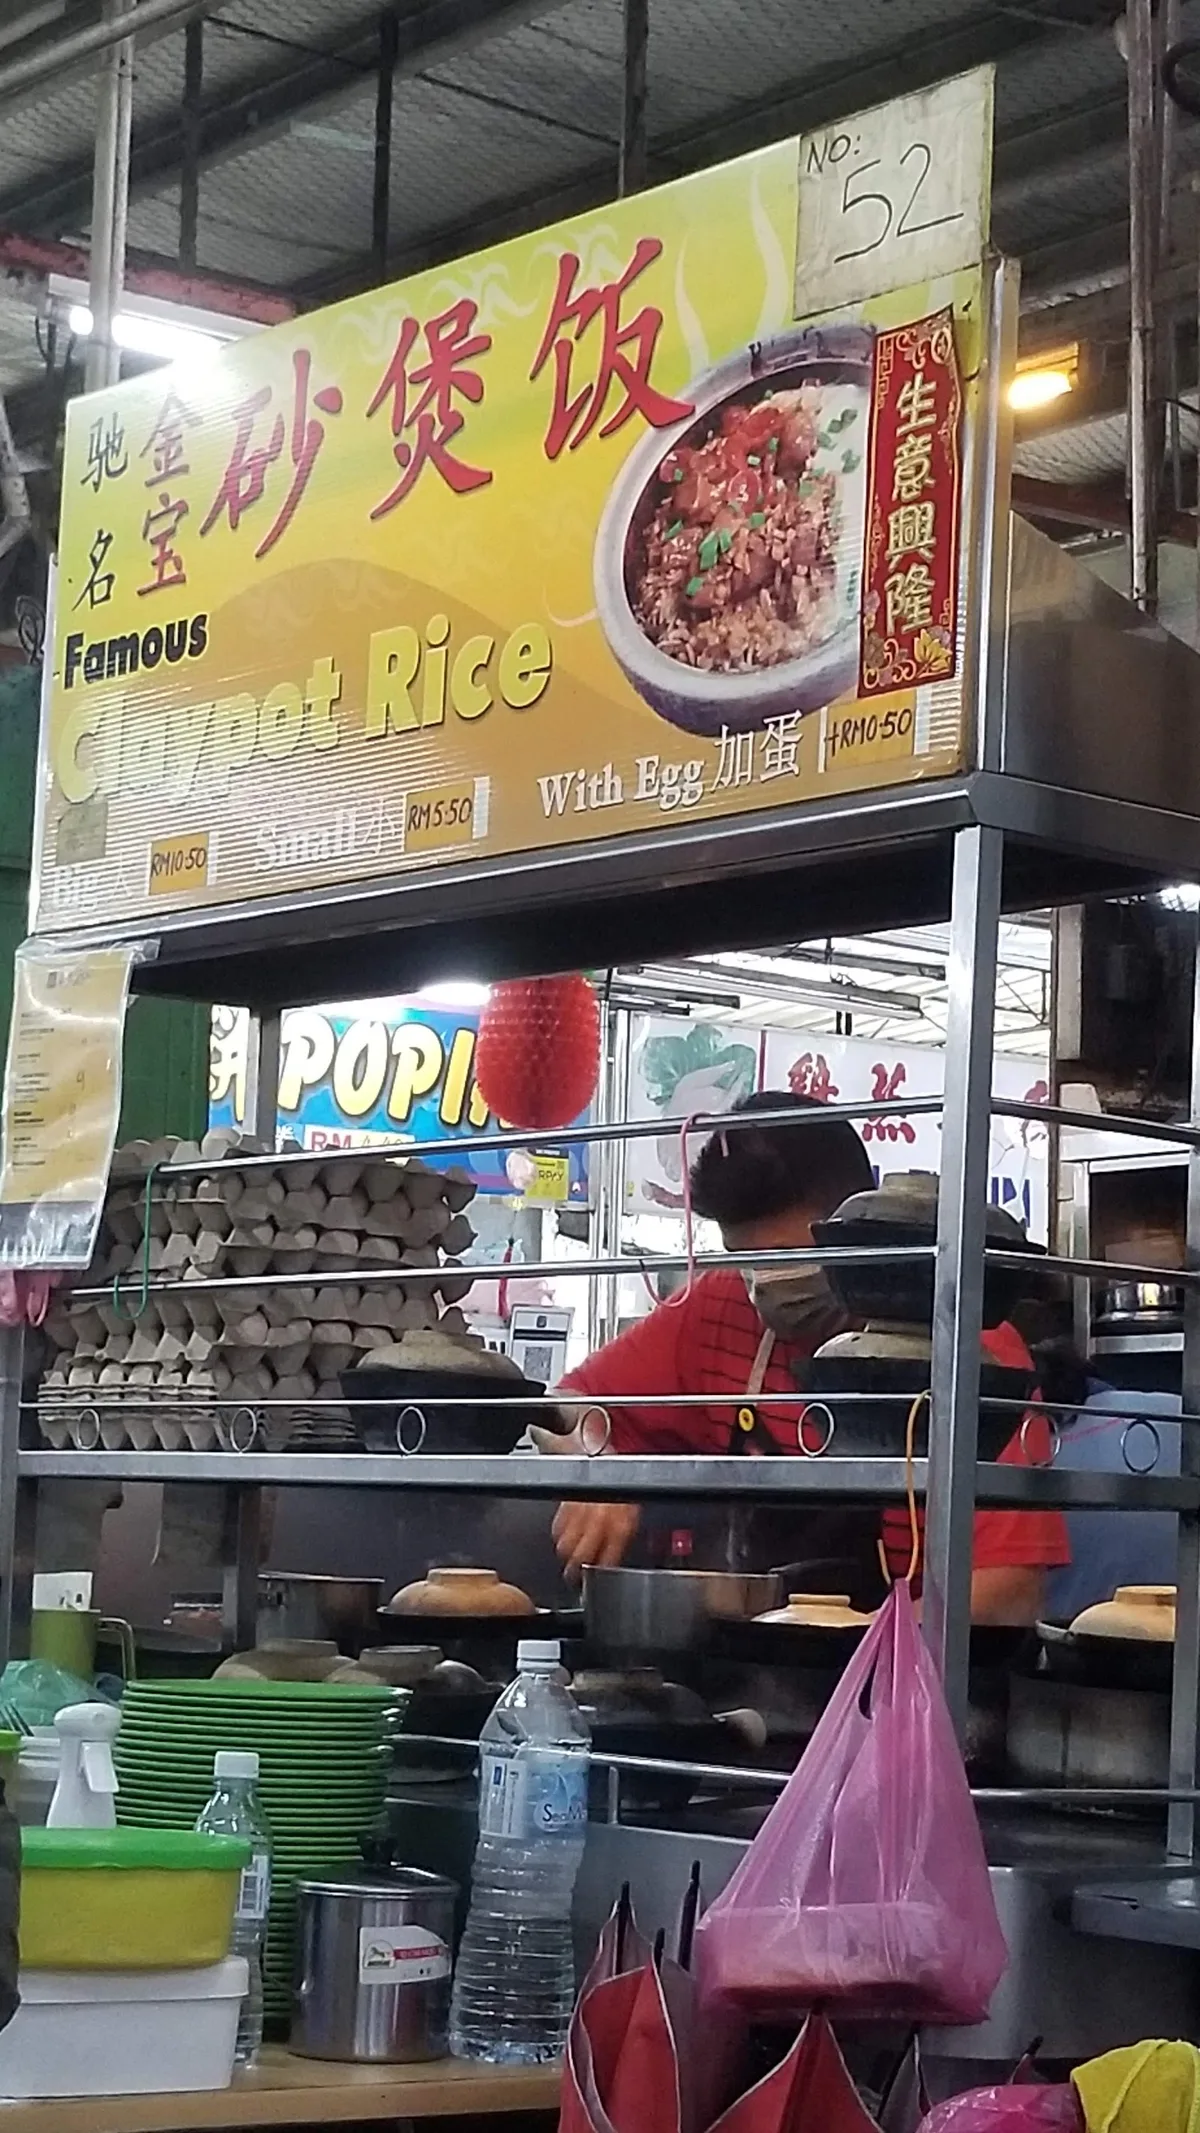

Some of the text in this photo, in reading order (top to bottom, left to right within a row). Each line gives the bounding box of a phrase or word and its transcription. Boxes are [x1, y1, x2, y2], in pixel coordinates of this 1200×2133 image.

[807, 134, 861, 173] NO:
[833, 143, 965, 264] 52
[71, 411, 129, 613] 驰名
[136, 388, 203, 597] 金宝
[884, 371, 937, 636] 生意興隆
[56, 613, 555, 804] Claypot Rice
[64, 613, 208, 690] Famous
[537, 708, 804, 817] With Egg 加蛋
